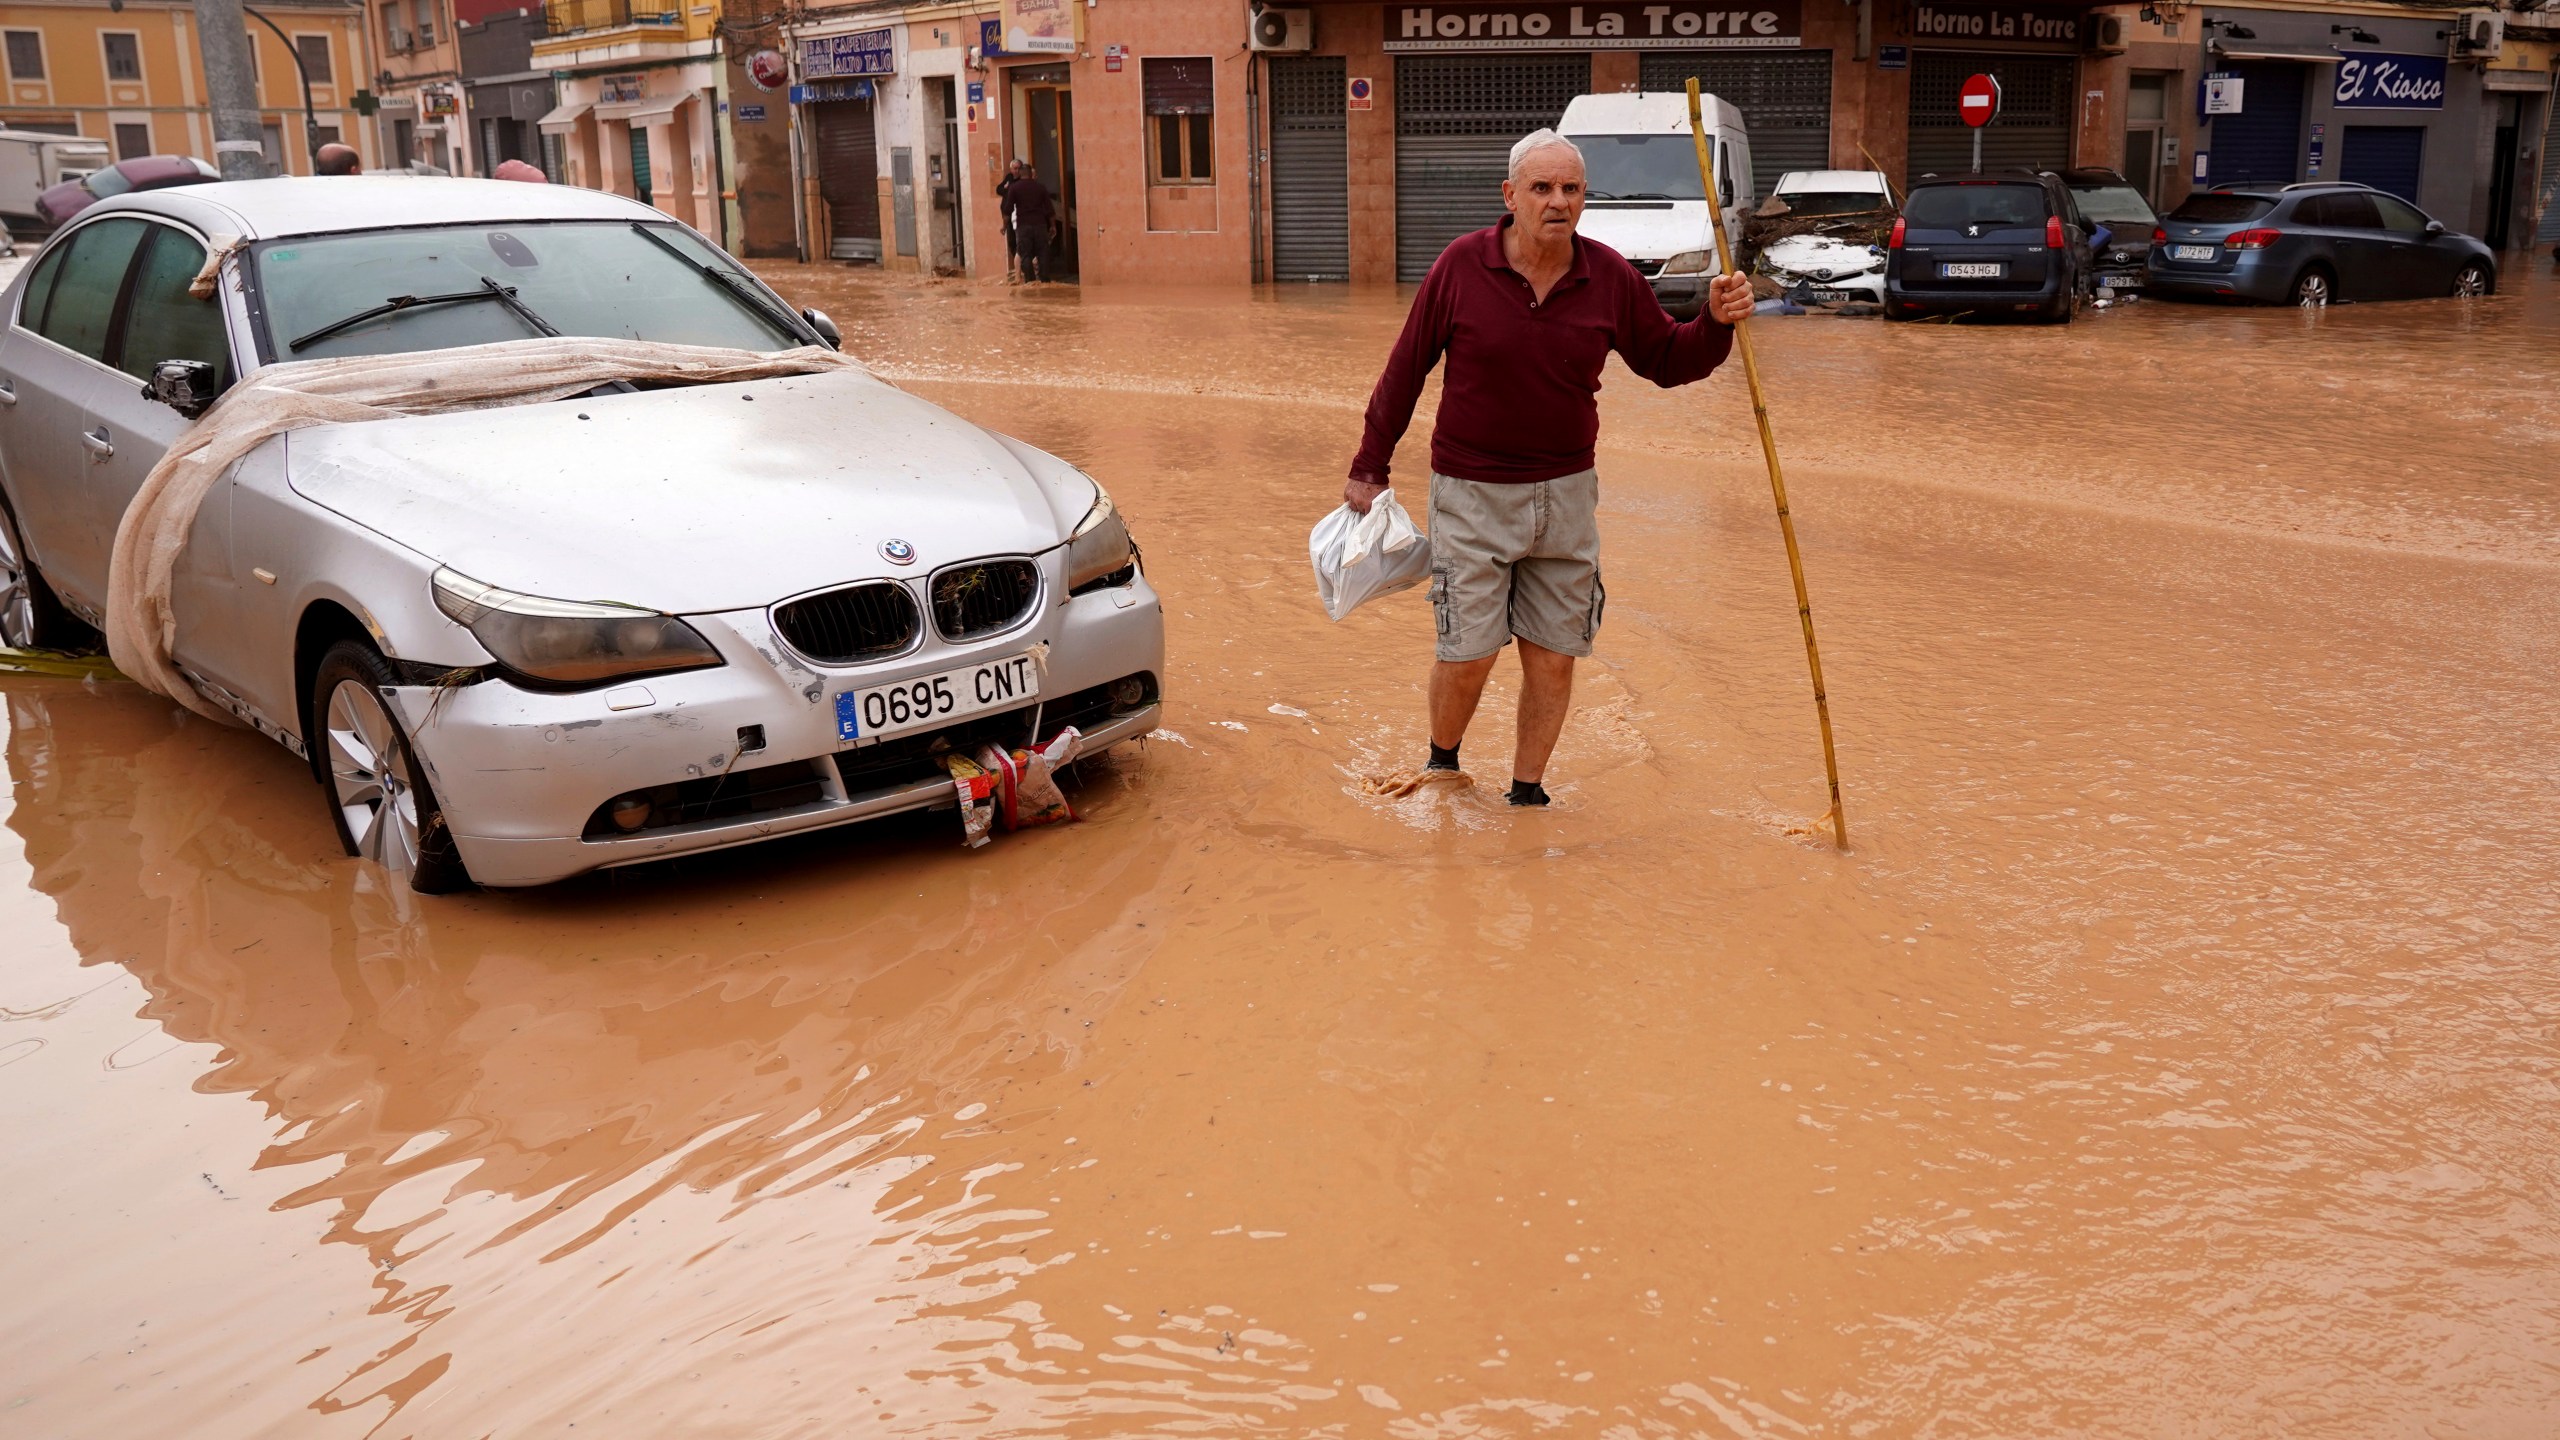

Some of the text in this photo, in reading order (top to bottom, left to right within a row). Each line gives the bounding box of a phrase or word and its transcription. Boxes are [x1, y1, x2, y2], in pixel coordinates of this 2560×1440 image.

[1401, 5, 1779, 37] Horno La Torre
[1917, 7, 2076, 39] Horno La Torre
[807, 40, 831, 55] BAR
[833, 31, 892, 54] CAFETERIA
[834, 55, 862, 74] ALTO
[864, 51, 892, 73] TAJO
[802, 85, 821, 100] ALTO
[826, 83, 845, 98] TAJO
[2336, 60, 2442, 101] El Kiosco
[2179, 246, 2197, 256] 0172
[1950, 265, 1998, 275] 0543 HGJ
[843, 657, 1029, 733] E 0695 CNT
